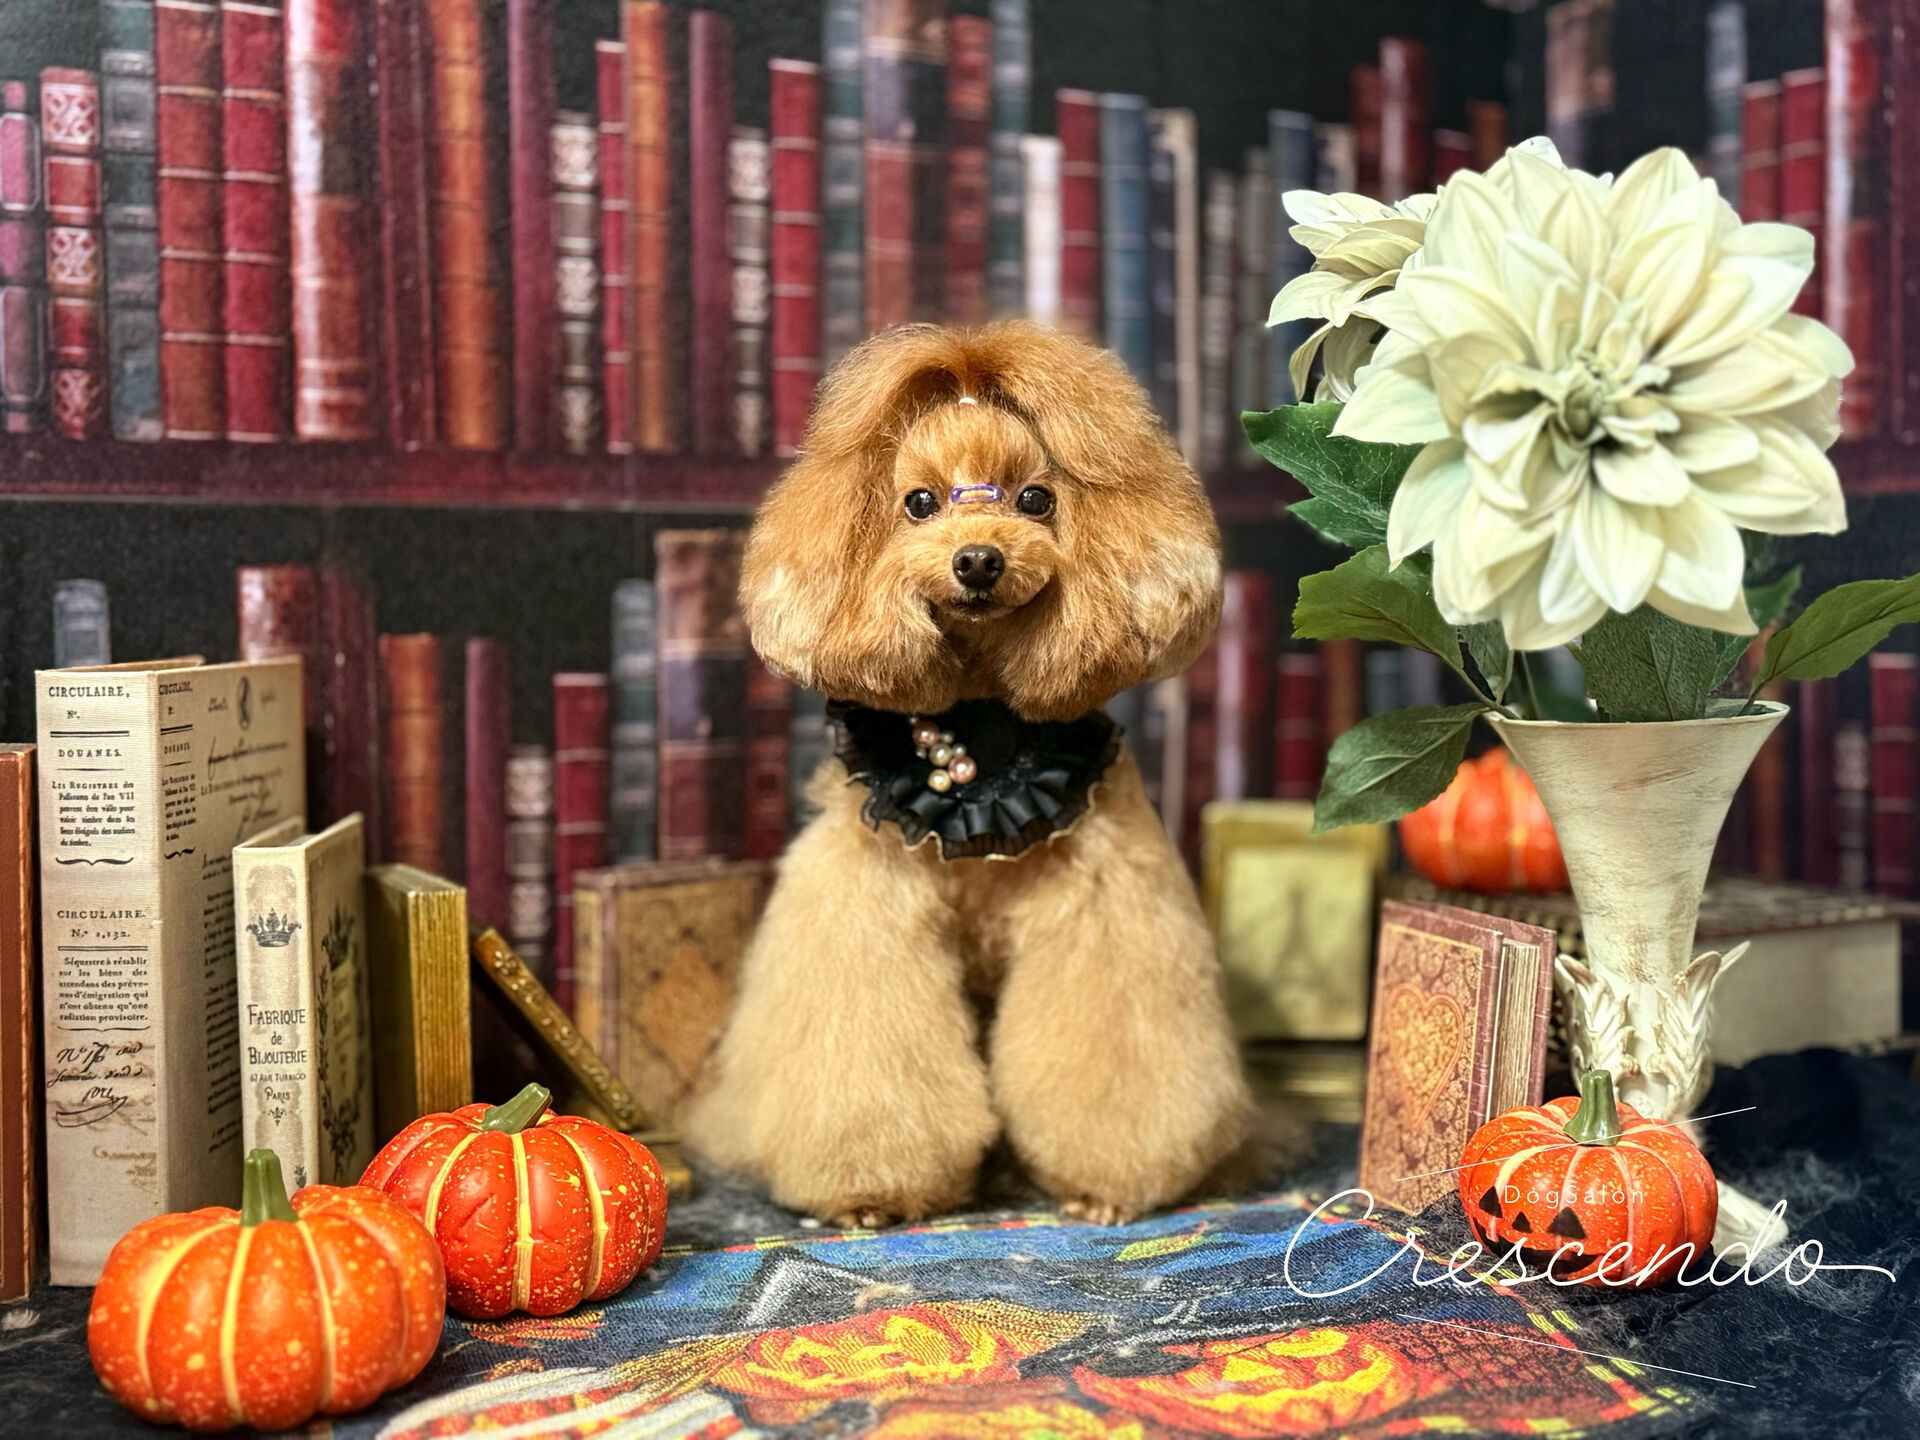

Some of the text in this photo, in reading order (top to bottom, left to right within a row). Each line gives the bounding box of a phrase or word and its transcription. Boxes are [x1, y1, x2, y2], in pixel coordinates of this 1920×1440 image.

[48, 686, 130, 699] CIRCULAIRE,
[98, 968, 123, 977] biens
[132, 968, 147, 977] des
[101, 980, 116, 988] des
[133, 990, 149, 1001] qui
[246, 1004, 307, 1025] FABRIQUE
[271, 1031, 283, 1045] de
[248, 1047, 308, 1065] BIJOUTERIE
[264, 1086, 291, 1104] PARIS
